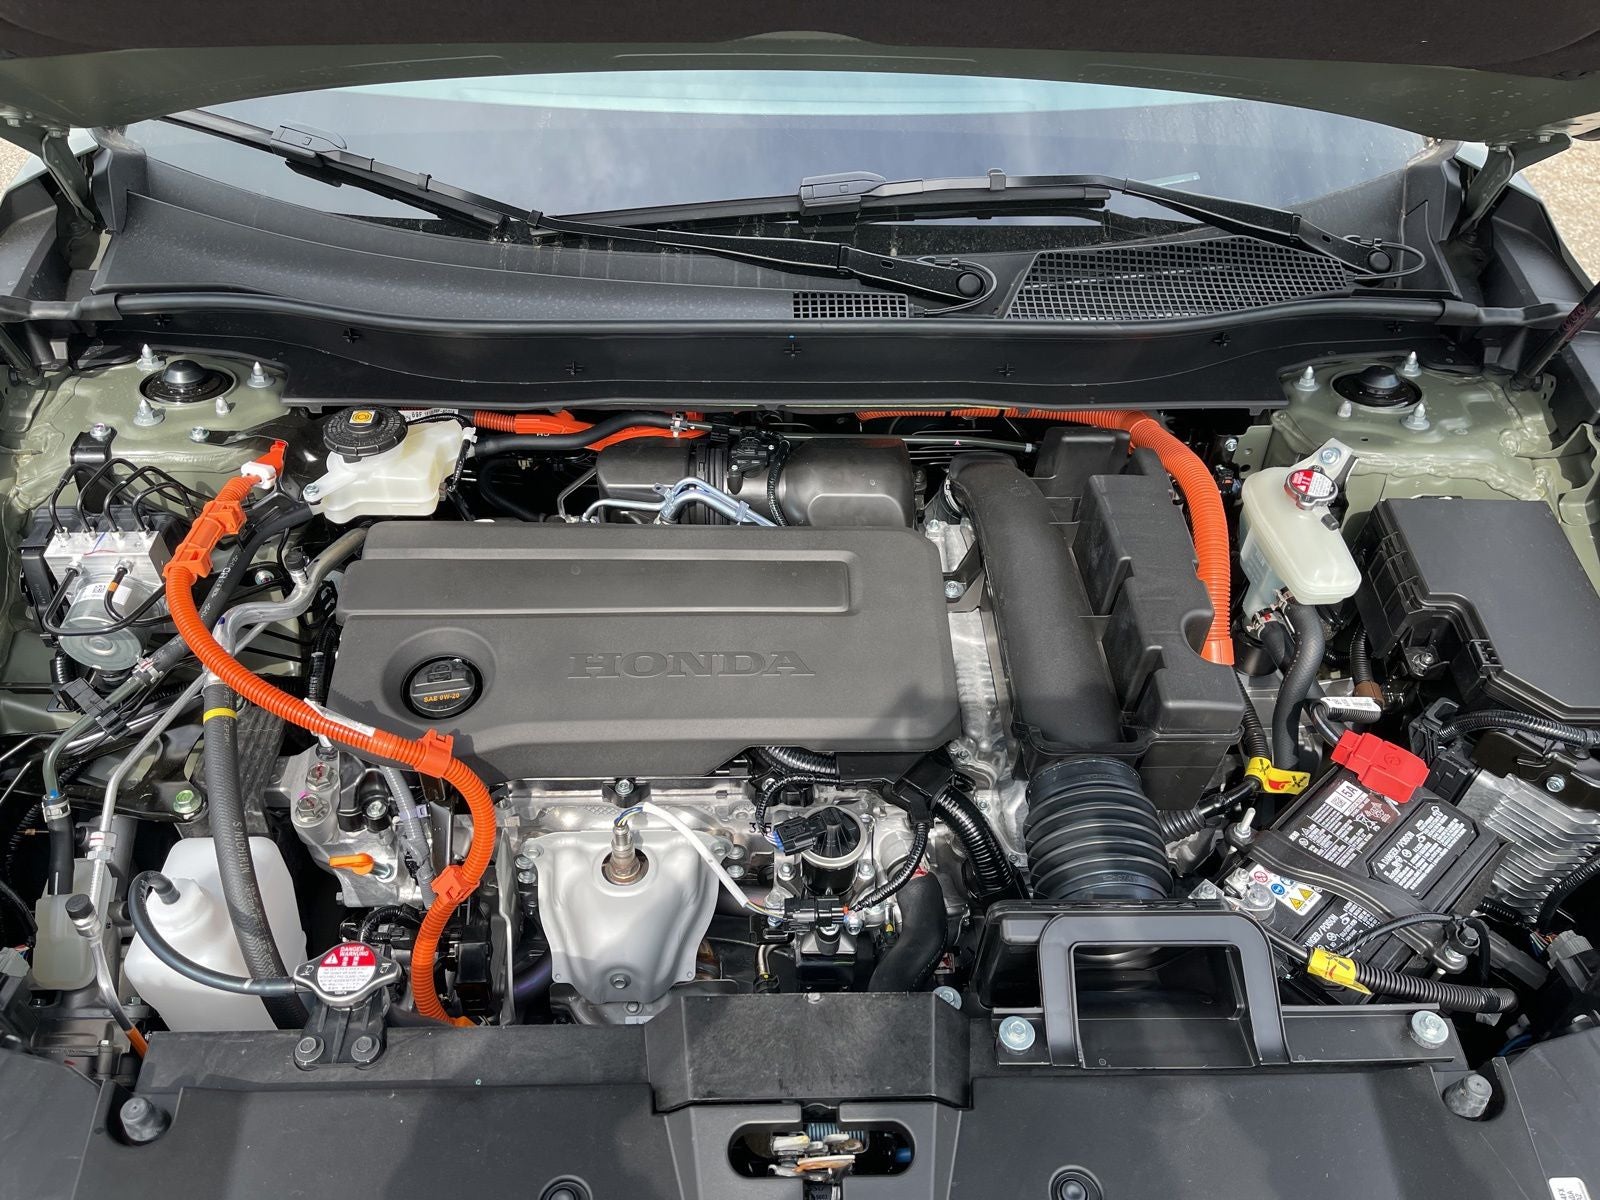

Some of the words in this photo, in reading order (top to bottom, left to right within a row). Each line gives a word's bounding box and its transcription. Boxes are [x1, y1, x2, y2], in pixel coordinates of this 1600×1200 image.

[568, 651, 816, 679] HONDA
[423, 695, 438, 703] SAE
[439, 692, 460, 701] 0W-20
[1341, 785, 1358, 799] 5A
